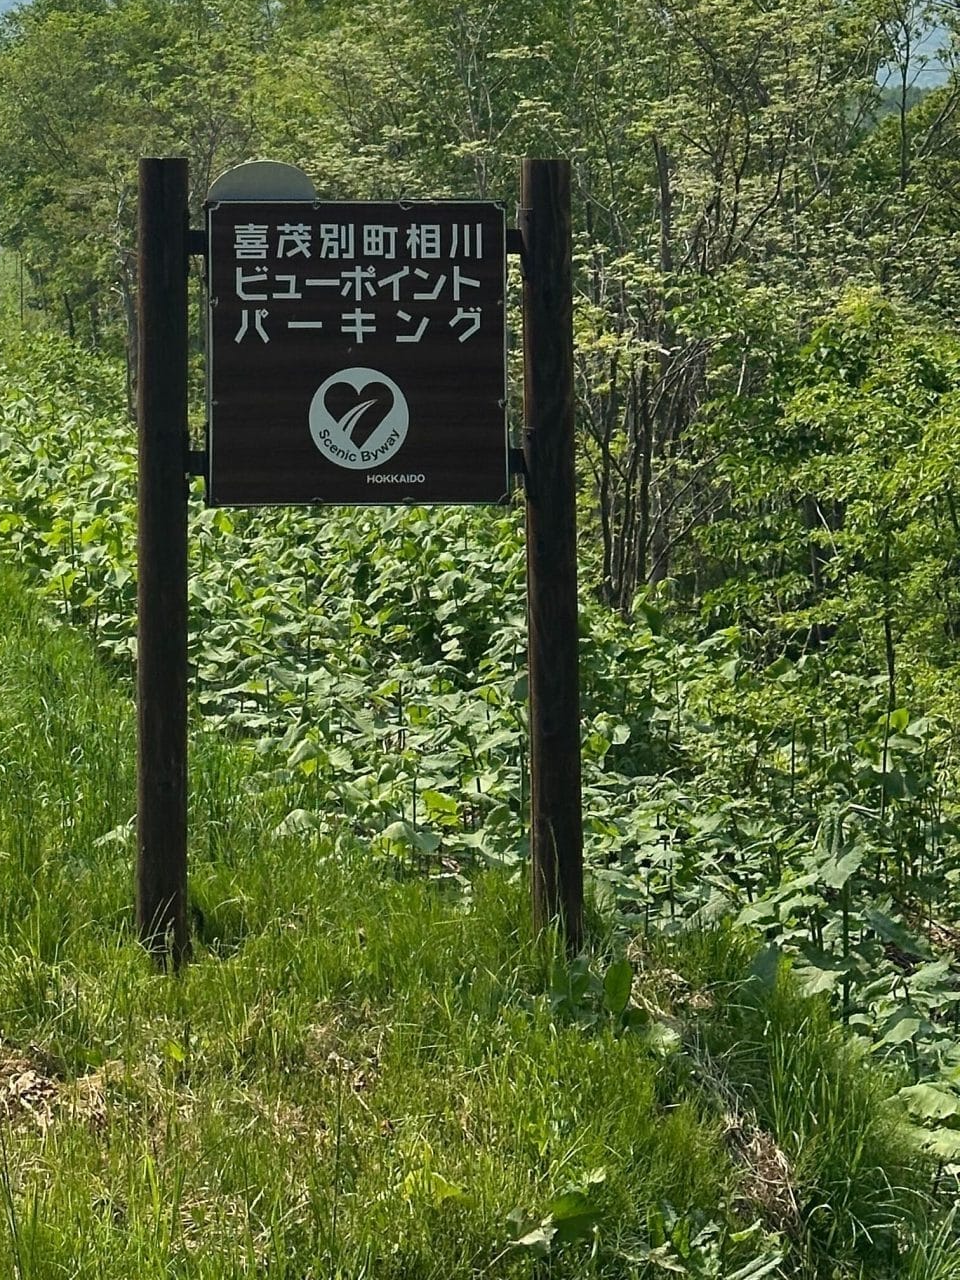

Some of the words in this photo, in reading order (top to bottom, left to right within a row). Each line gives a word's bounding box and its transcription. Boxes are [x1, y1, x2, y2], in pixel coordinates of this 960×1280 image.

[233, 223, 483, 260] 喜茂別町相川
[236, 265, 481, 301] ビューポイント
[234, 307, 482, 344] パーキング
[319, 428, 357, 462] Scenic
[360, 428, 400, 462] Byway
[366, 474, 426, 484] HOKKAIDO
